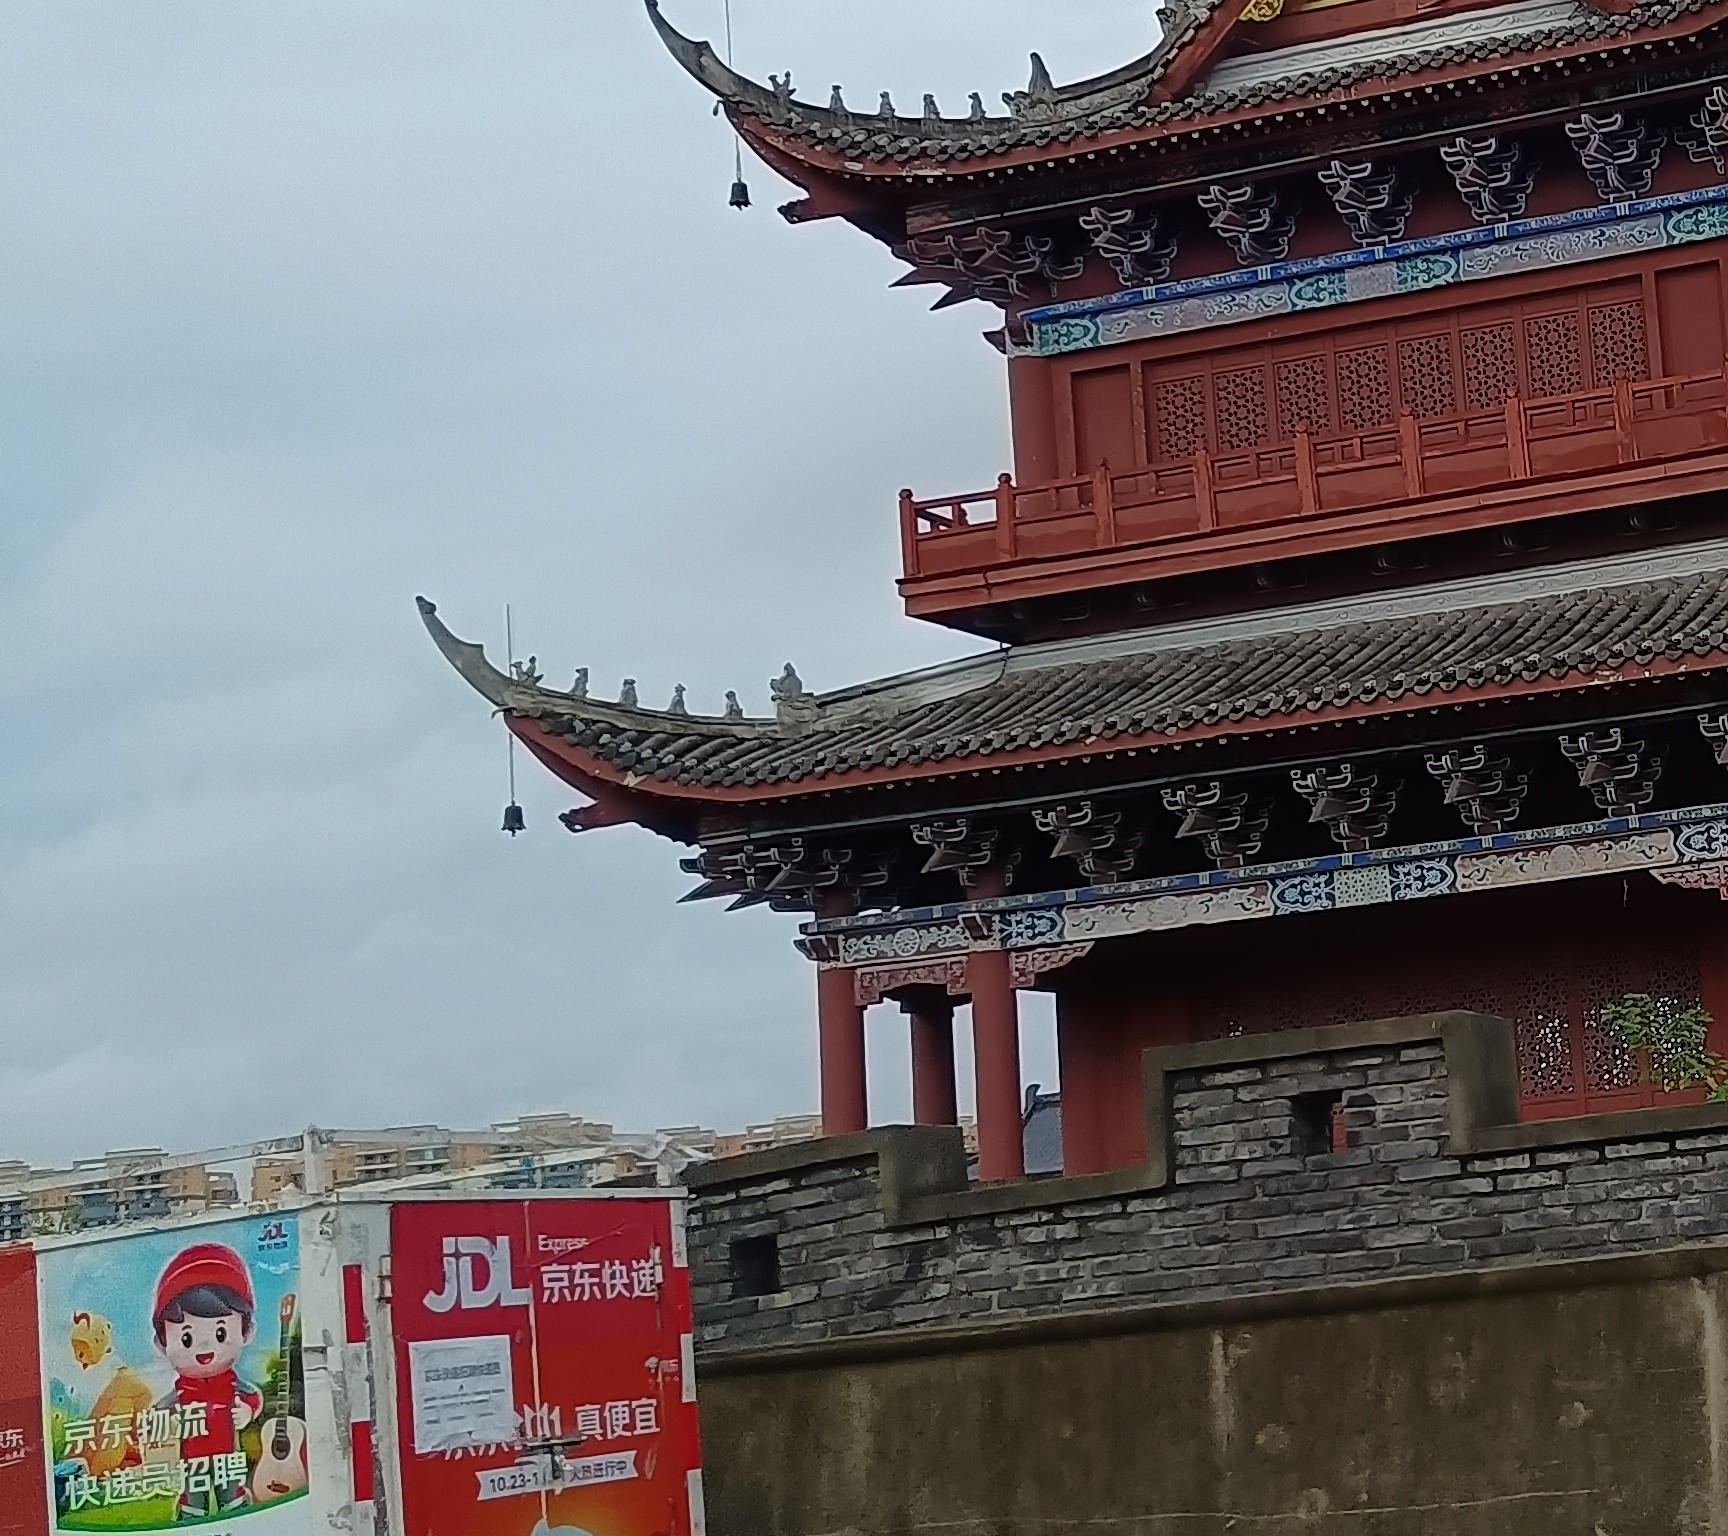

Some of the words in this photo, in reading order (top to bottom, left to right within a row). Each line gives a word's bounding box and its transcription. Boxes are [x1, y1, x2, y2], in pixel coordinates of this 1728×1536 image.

[423, 1235, 532, 1313] JDL
[540, 1260, 660, 1304] 京东快递
[63, 1401, 209, 1456] 京东物流
[575, 1397, 661, 1442] 真便宜
[66, 1452, 249, 1510] 快递员招聘
